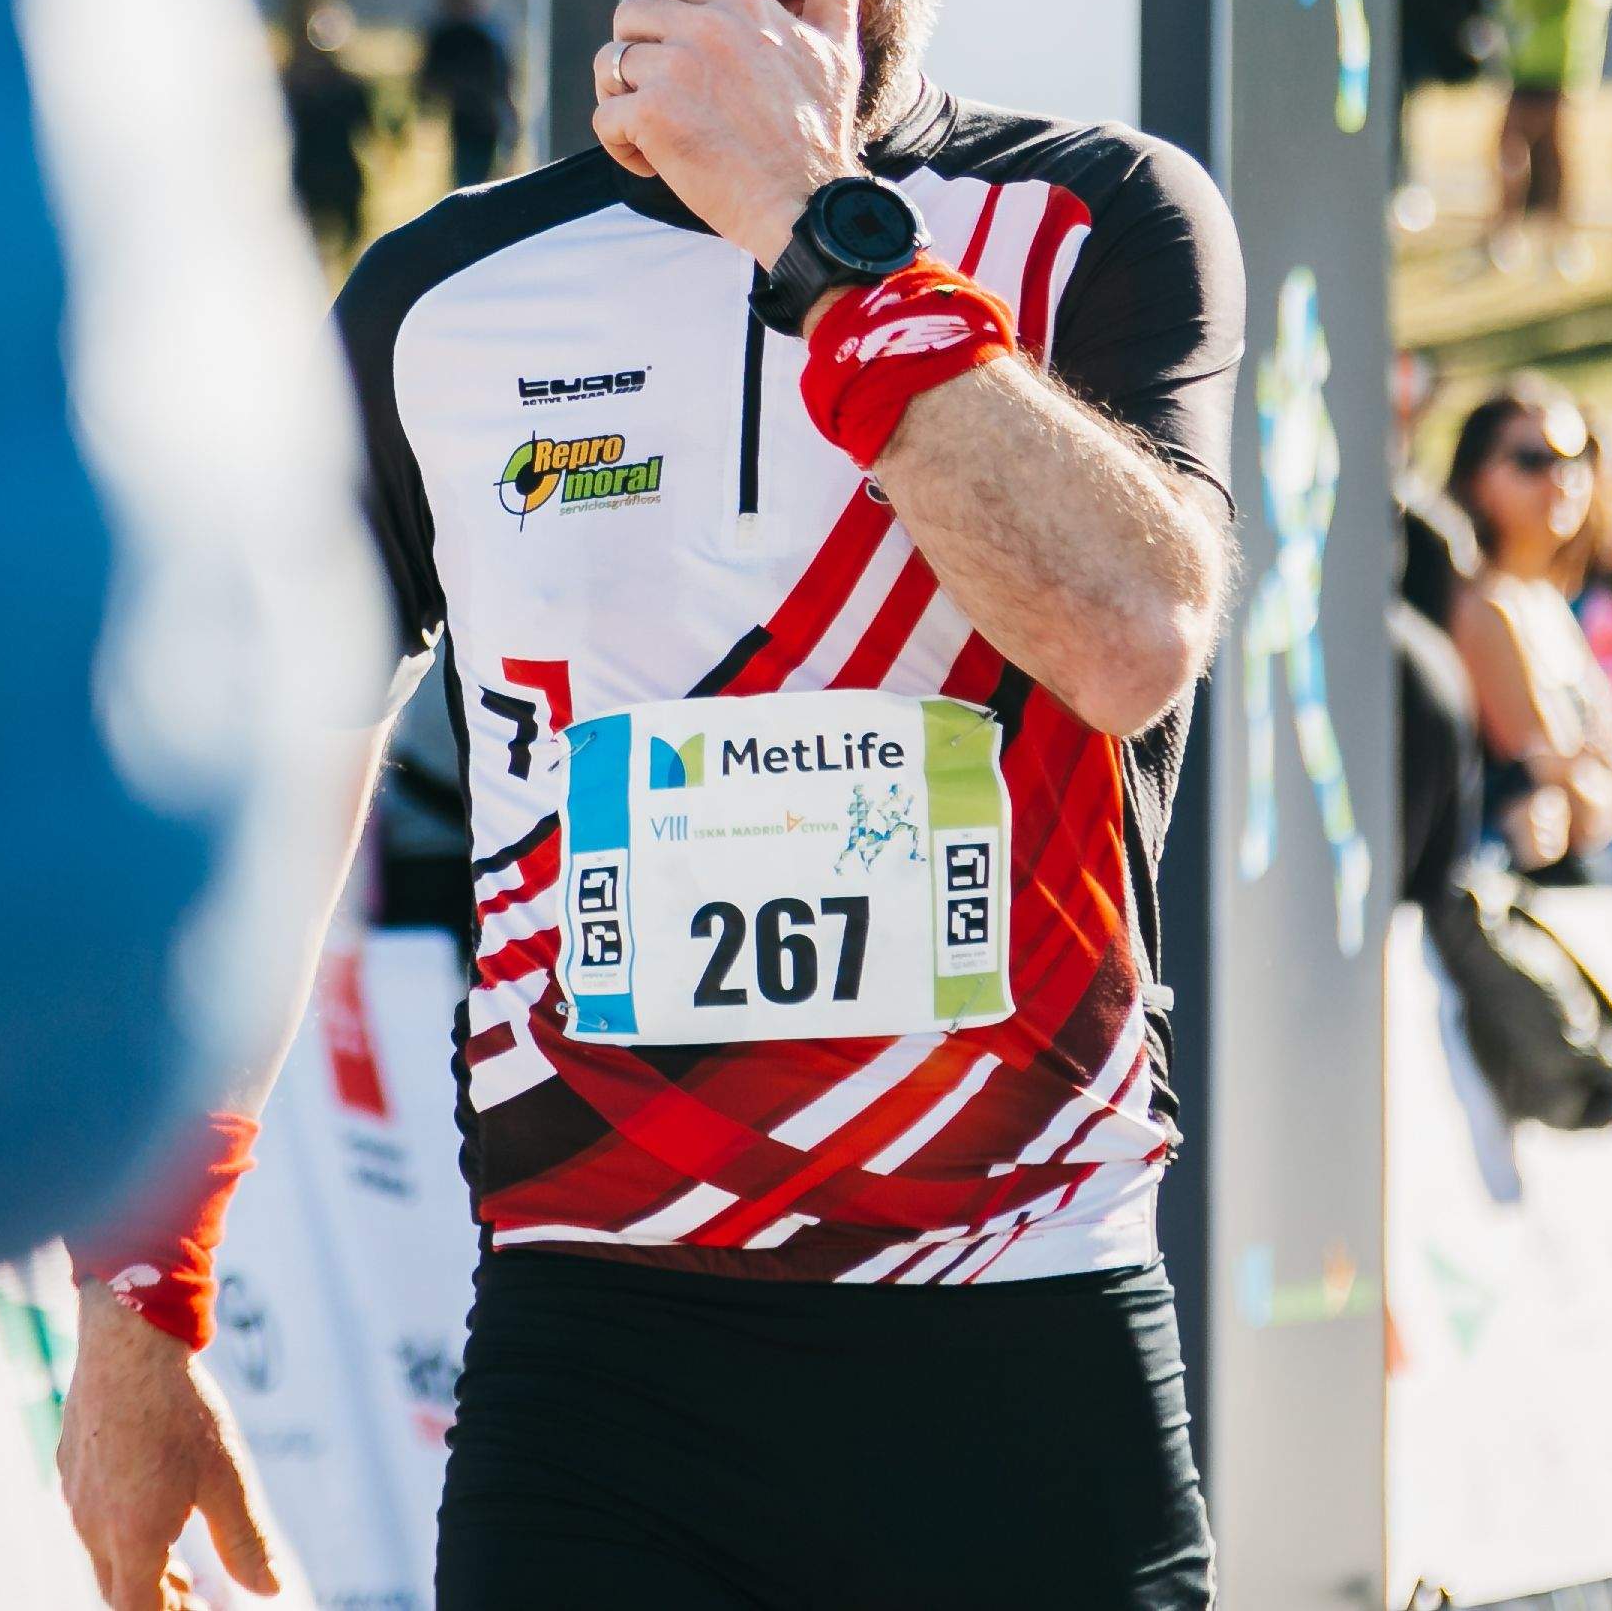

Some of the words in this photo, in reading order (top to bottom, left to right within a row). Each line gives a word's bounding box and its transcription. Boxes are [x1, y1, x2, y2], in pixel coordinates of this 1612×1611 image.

[533, 434, 626, 473] Repro
[561, 456, 663, 503] moral
[722, 731, 905, 777] MetLife
[651, 815, 688, 841] VIII
[732, 824, 785, 838] MADRID
[690, 896, 870, 1009] 267
